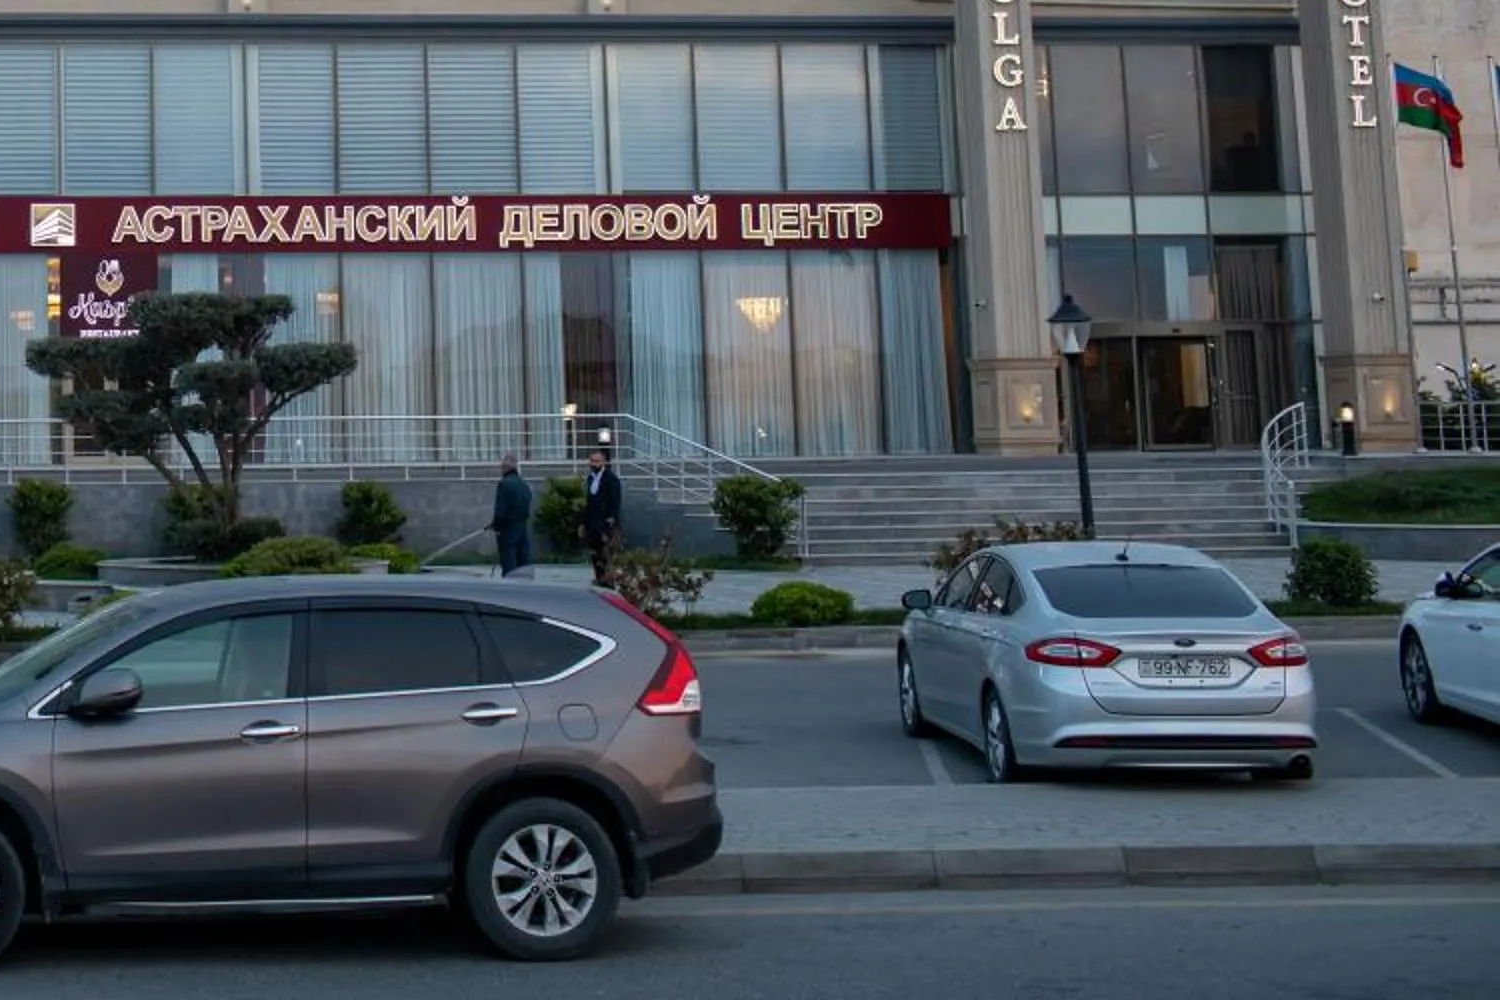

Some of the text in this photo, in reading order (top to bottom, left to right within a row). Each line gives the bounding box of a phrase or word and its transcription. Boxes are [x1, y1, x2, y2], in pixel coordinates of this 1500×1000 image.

[112, 195, 883, 247] АСТРАХАНСКИЙ ДЕЛОВОЙ ЦЕНТР
